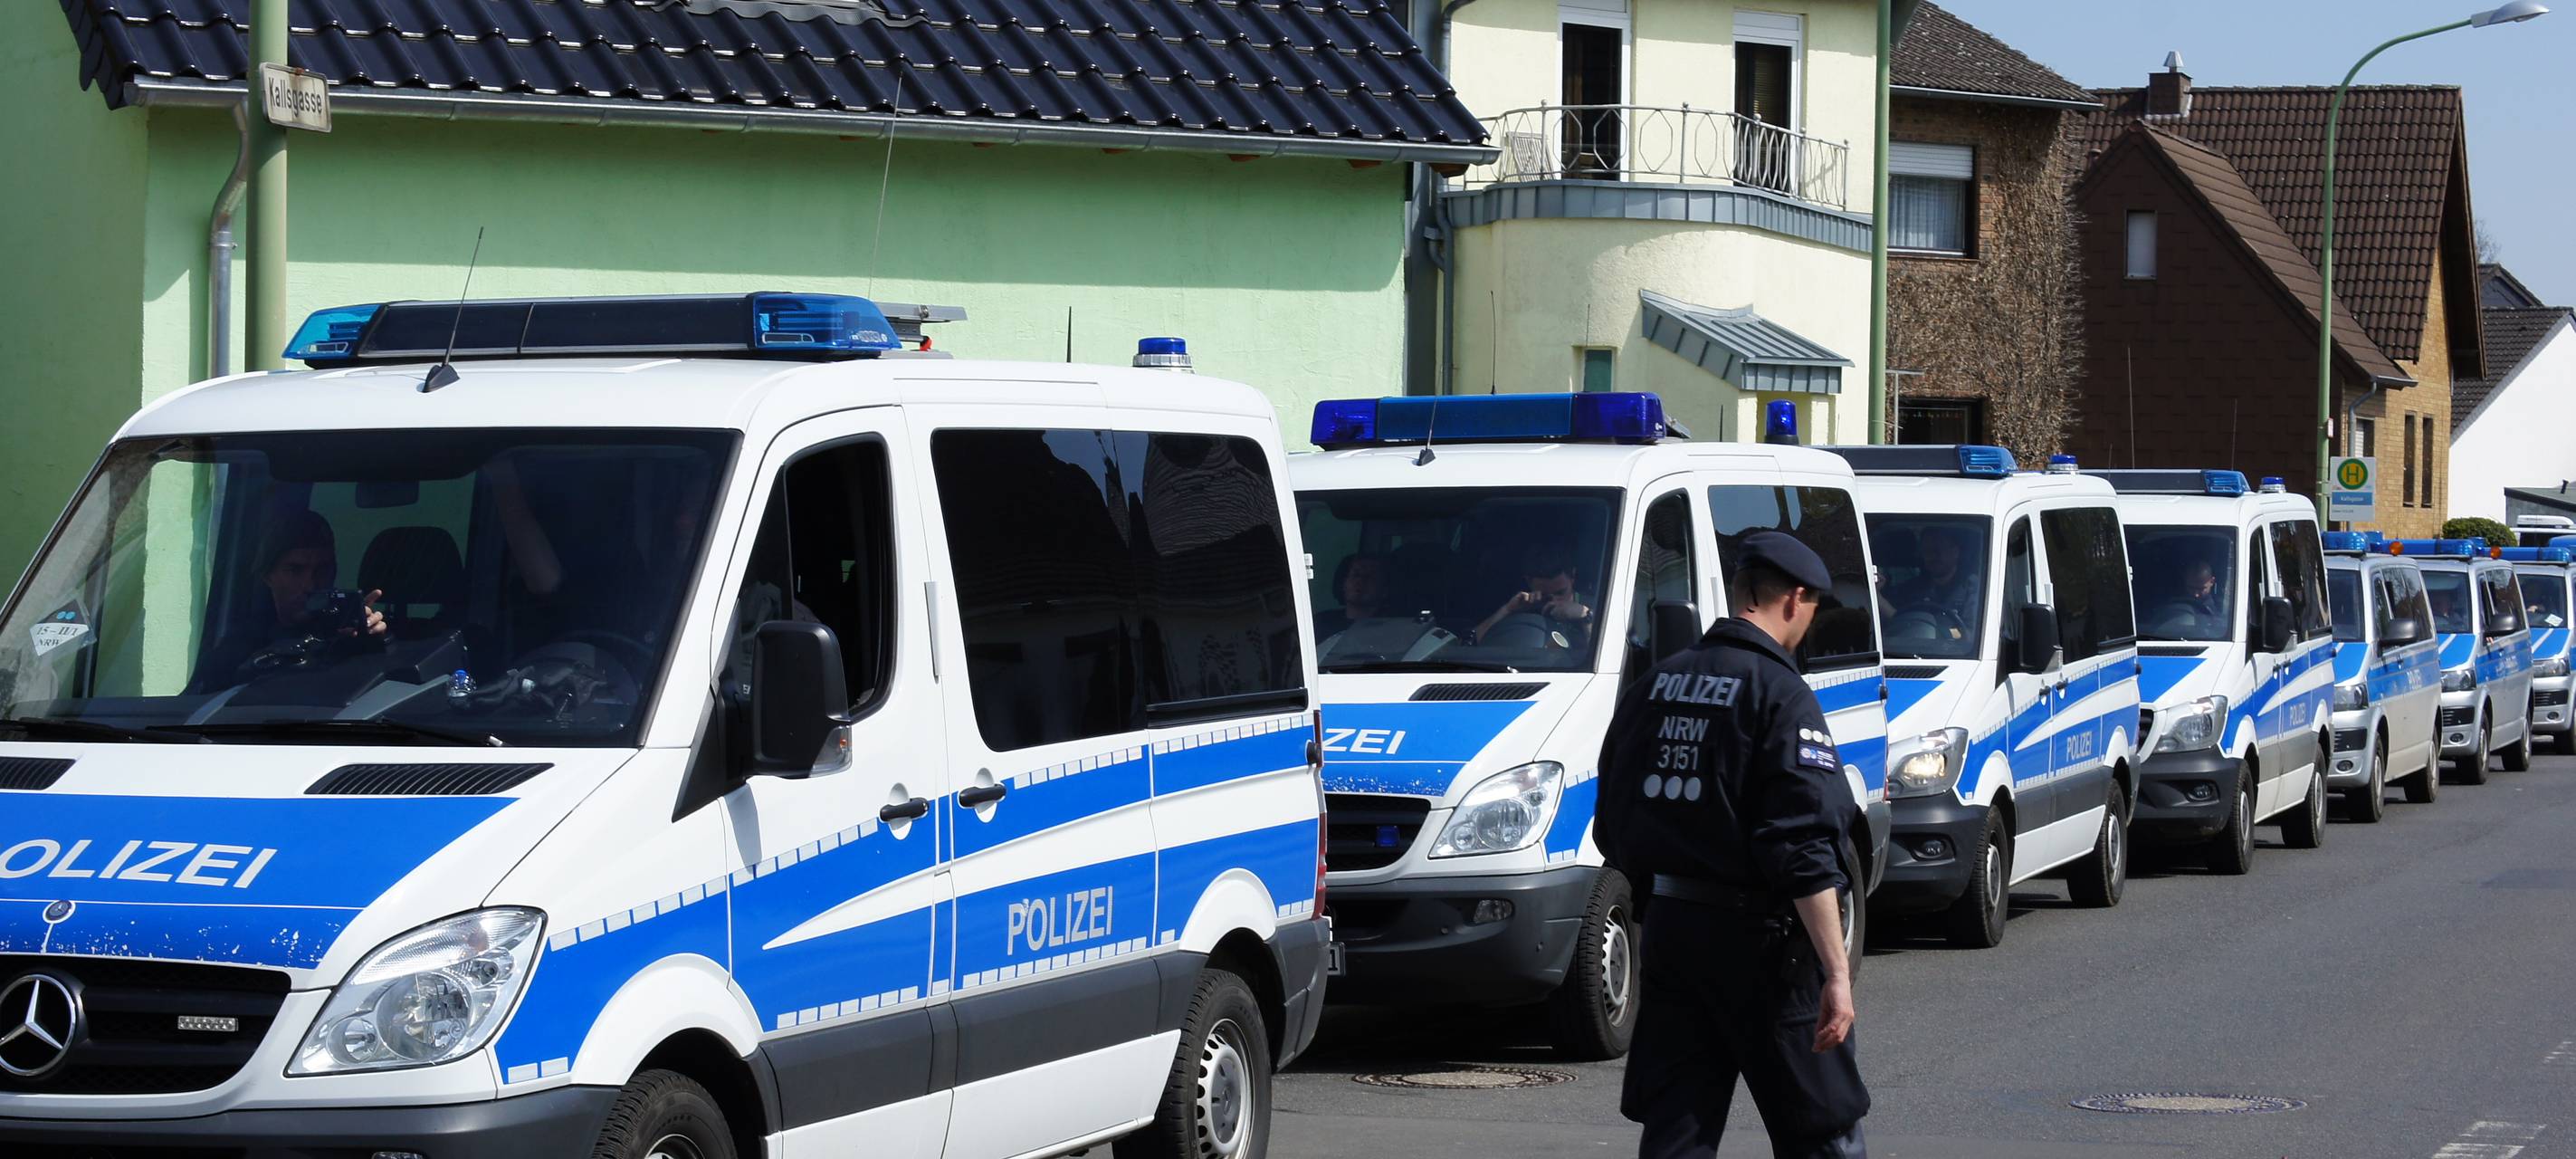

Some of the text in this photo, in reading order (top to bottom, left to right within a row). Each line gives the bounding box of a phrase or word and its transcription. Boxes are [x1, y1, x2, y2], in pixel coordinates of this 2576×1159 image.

[268, 76, 322, 118] Kallsgasse
[2346, 465, 2359, 483] H
[1648, 672, 1742, 706] POLIZEI
[1321, 728, 1407, 755] ZEI
[1657, 715, 1710, 742] NRW
[1657, 744, 1699, 771] 3151
[2066, 731, 2093, 763] POLIZEI
[0, 838, 279, 889] OLIZEI
[1007, 885, 1113, 956] POLIZEI
